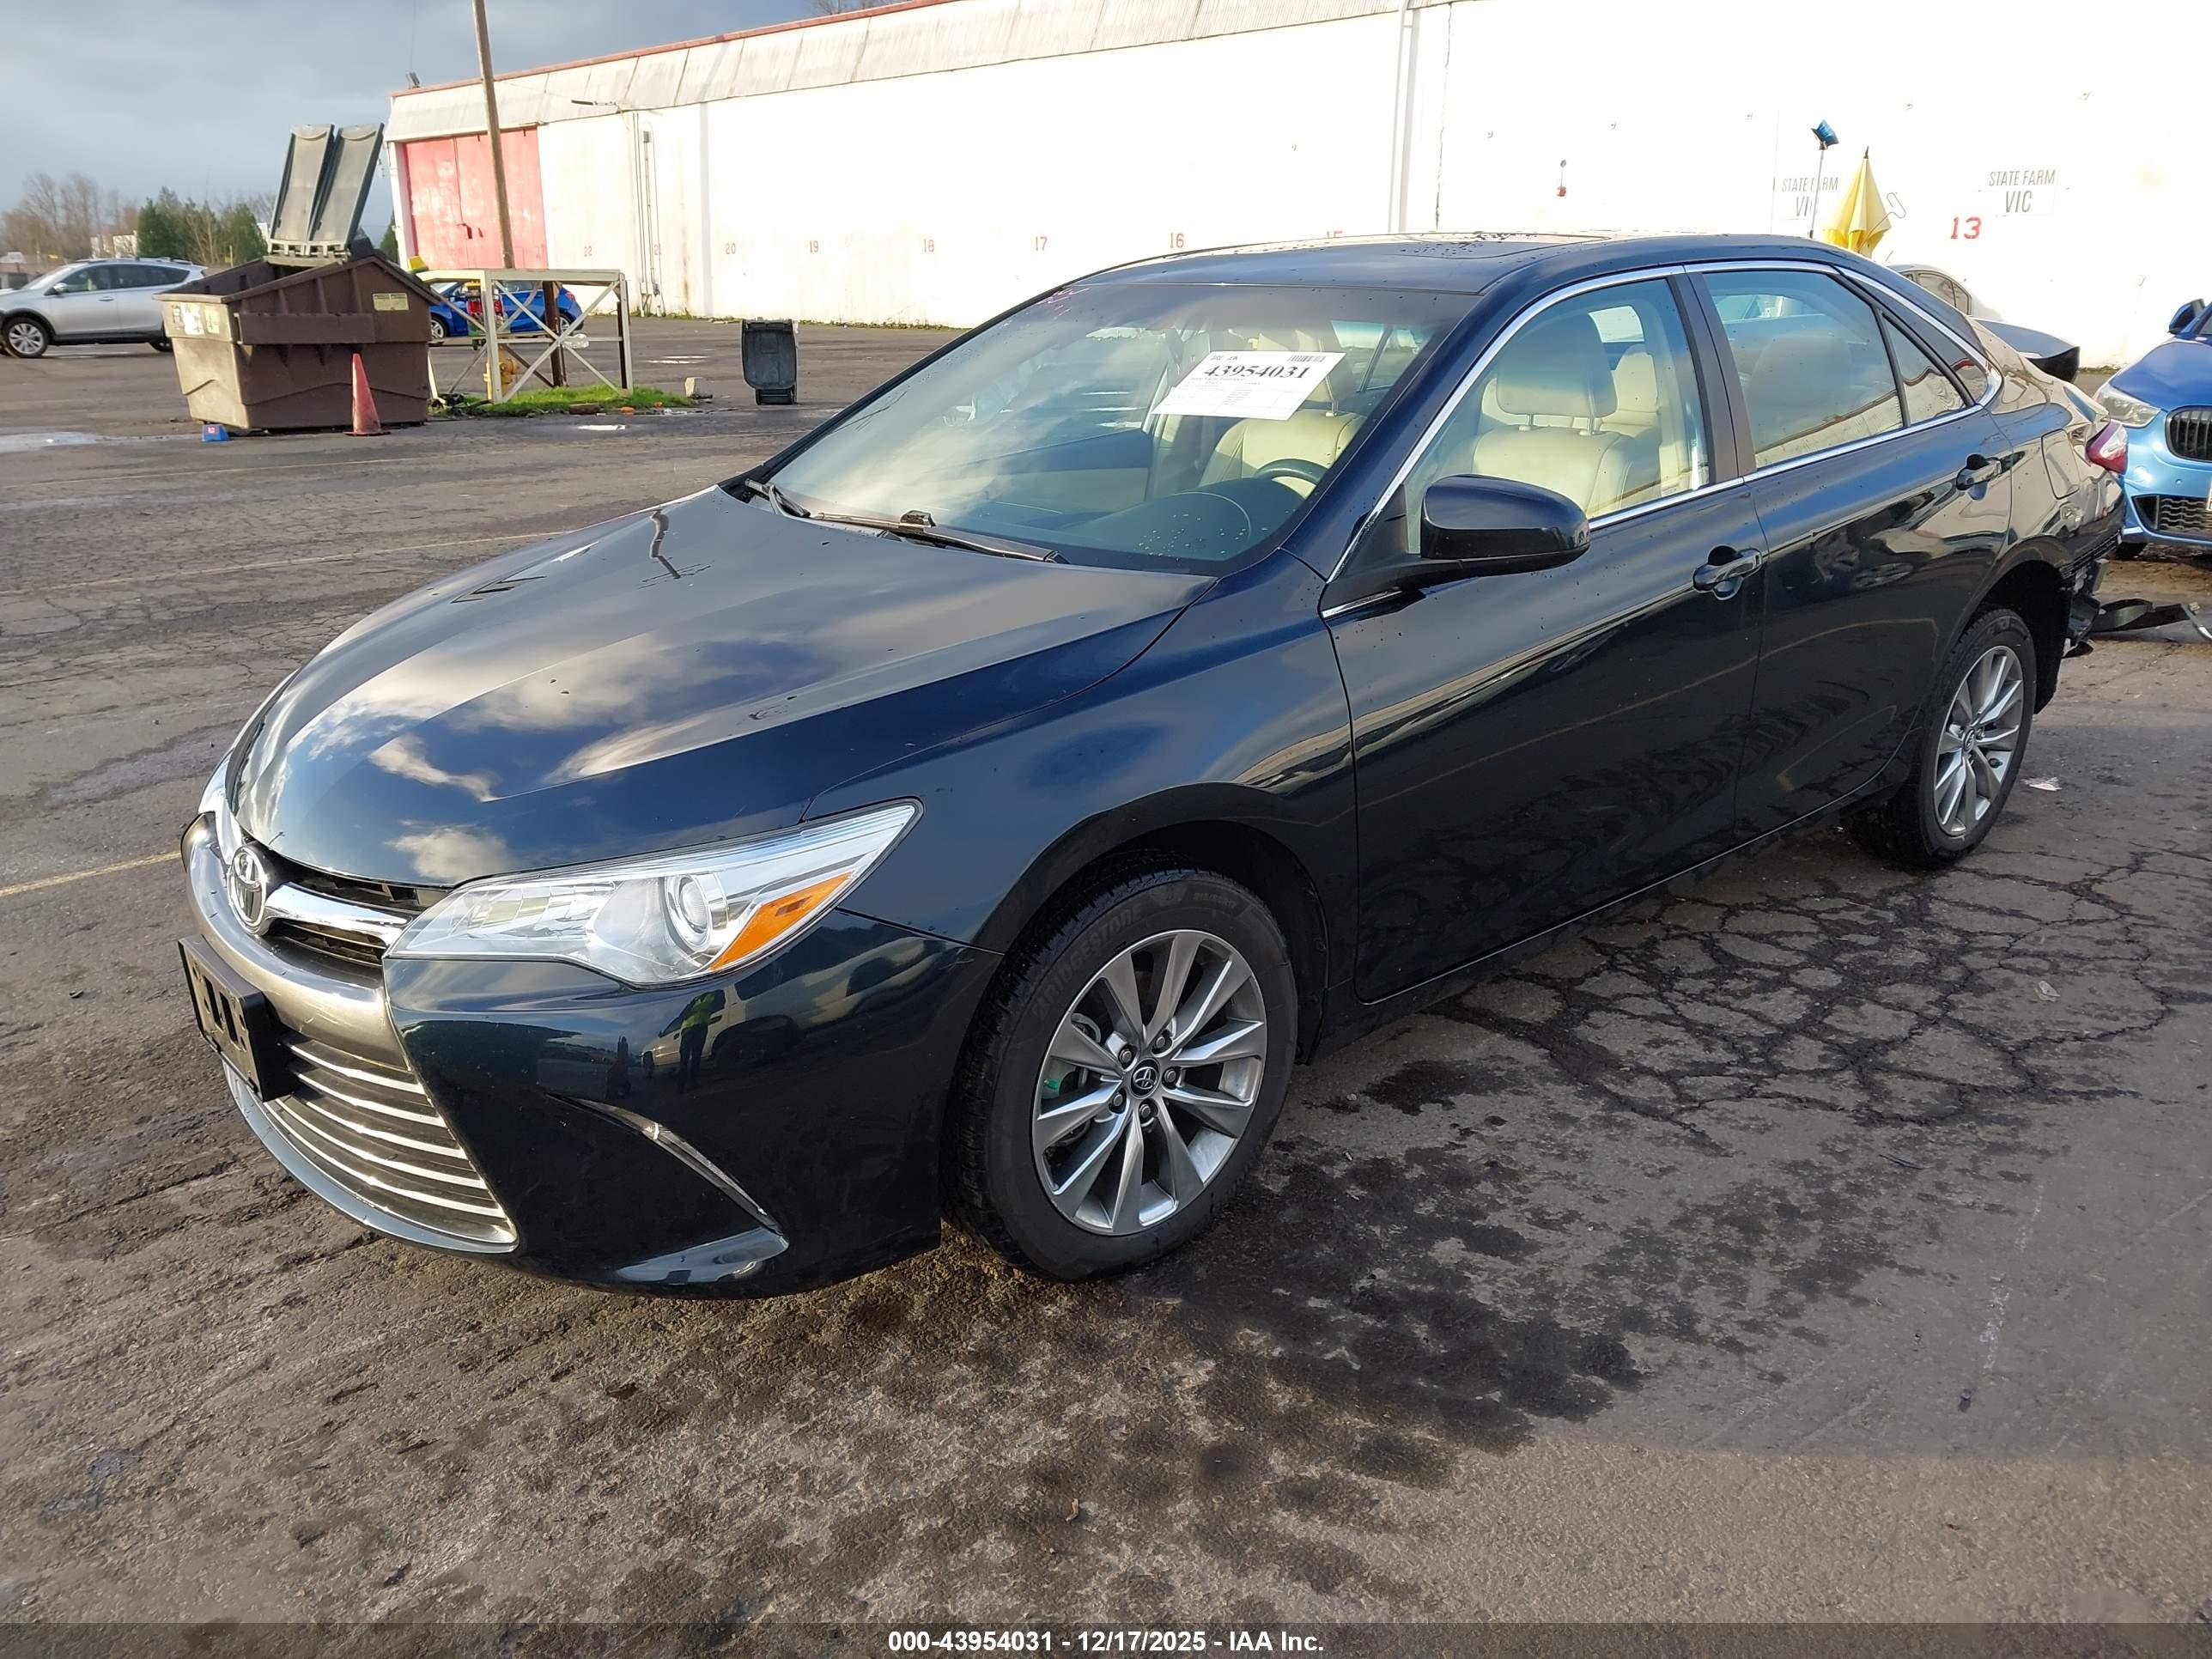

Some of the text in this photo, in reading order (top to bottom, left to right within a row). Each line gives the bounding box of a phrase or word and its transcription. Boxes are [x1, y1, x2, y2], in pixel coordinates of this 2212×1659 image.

[1989, 168, 2056, 186] STATE FARM
[1781, 178, 1808, 192] STATE
[2006, 190, 2033, 213] VIC
[1950, 216, 1982, 240] 13
[725, 242, 737, 255] 20
[809, 240, 819, 253] 19
[923, 239, 935, 252] 18
[1034, 235, 1048, 252] 17
[1170, 233, 1185, 249] 16
[583, 245, 593, 257] 22
[1204, 364, 1310, 379] 43954031
